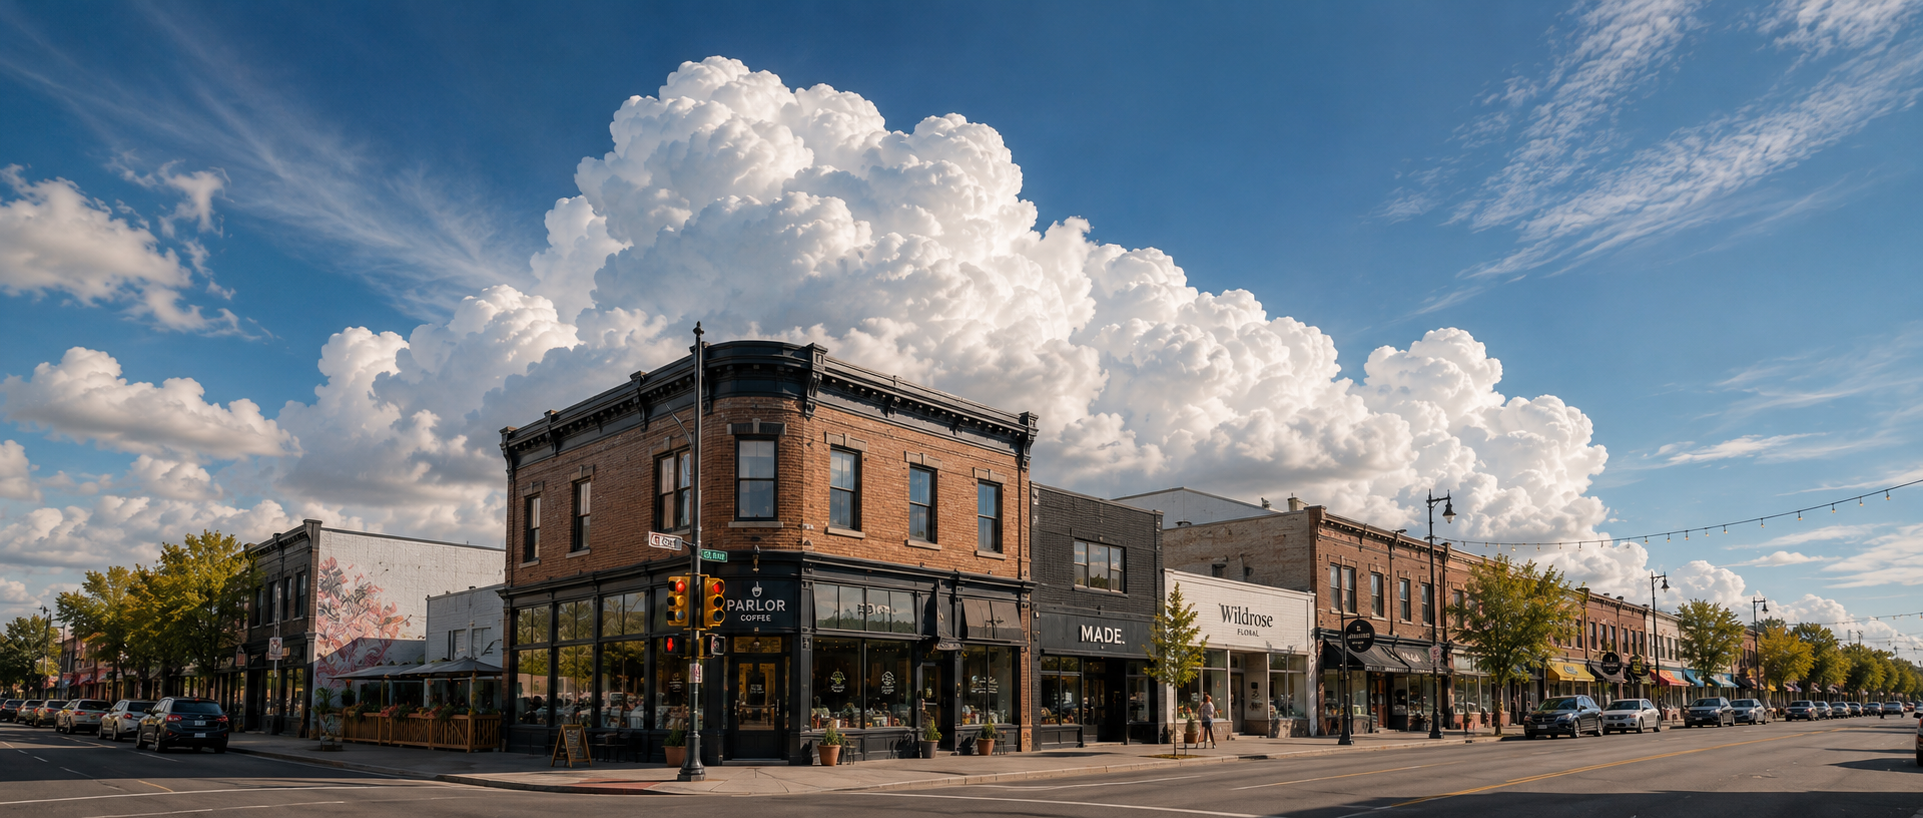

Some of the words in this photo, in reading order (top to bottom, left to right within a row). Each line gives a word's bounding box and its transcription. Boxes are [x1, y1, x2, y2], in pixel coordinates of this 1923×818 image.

[726, 599, 786, 612] PARLOR
[740, 614, 772, 622] COFFEE
[1218, 603, 1273, 628] Wildrose
[1081, 624, 1126, 645] MADE.
